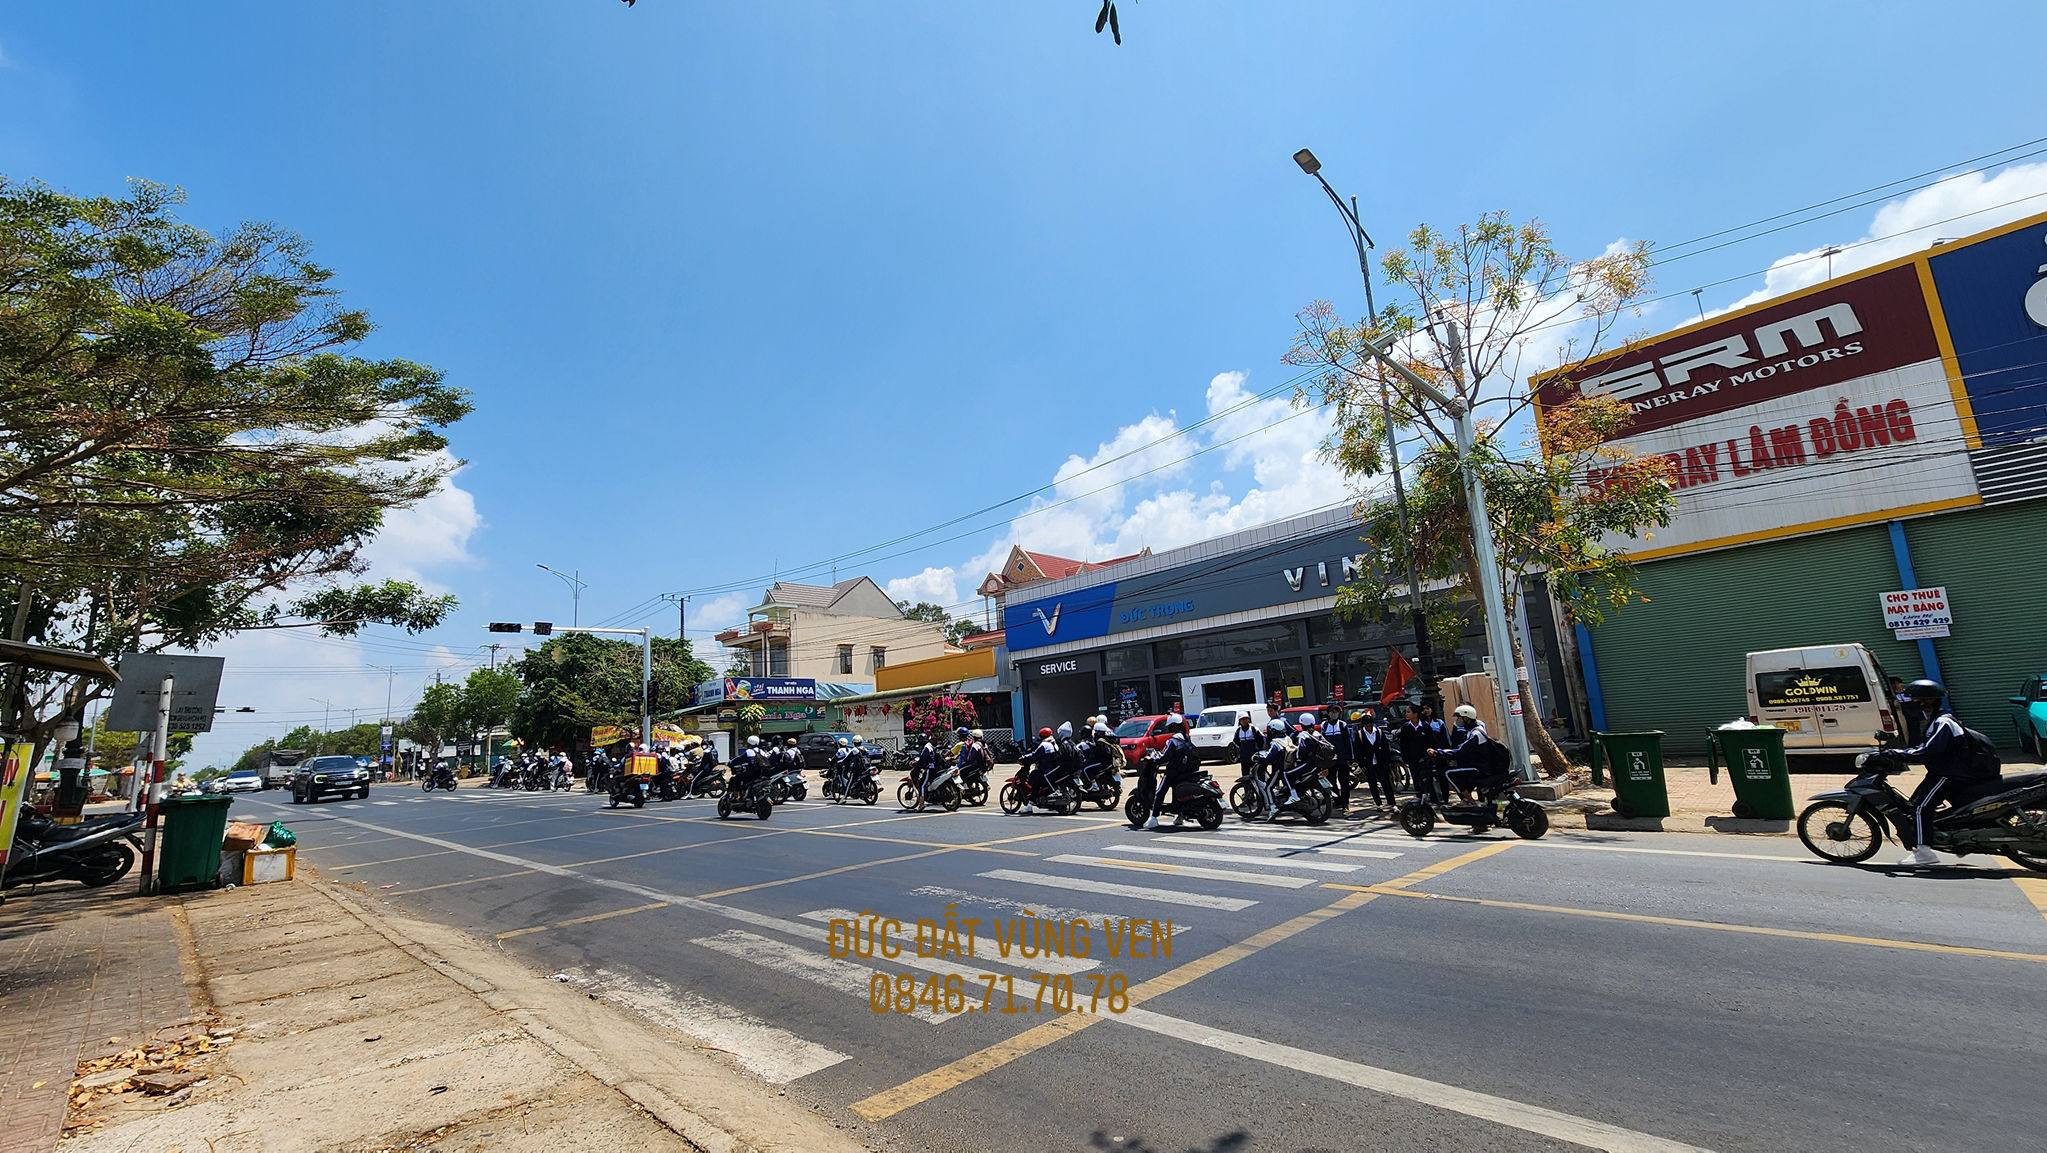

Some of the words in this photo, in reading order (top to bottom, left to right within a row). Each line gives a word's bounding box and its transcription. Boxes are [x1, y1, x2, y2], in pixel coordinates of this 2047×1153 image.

[1731, 341, 1864, 388] MOTORS
[1727, 424, 1808, 478] LÂM
[1808, 396, 1917, 460] ĐỒNG
[1887, 593, 1909, 603] CHO
[1912, 589, 1940, 600] THUÊ
[1888, 620, 1911, 628] 0819
[1913, 618, 1930, 626] 429
[1040, 660, 1077, 675] SERVICE
[767, 686, 795, 695] THANH
[796, 686, 815, 695] NGA
[1785, 685, 1838, 696] GOLDWIN
